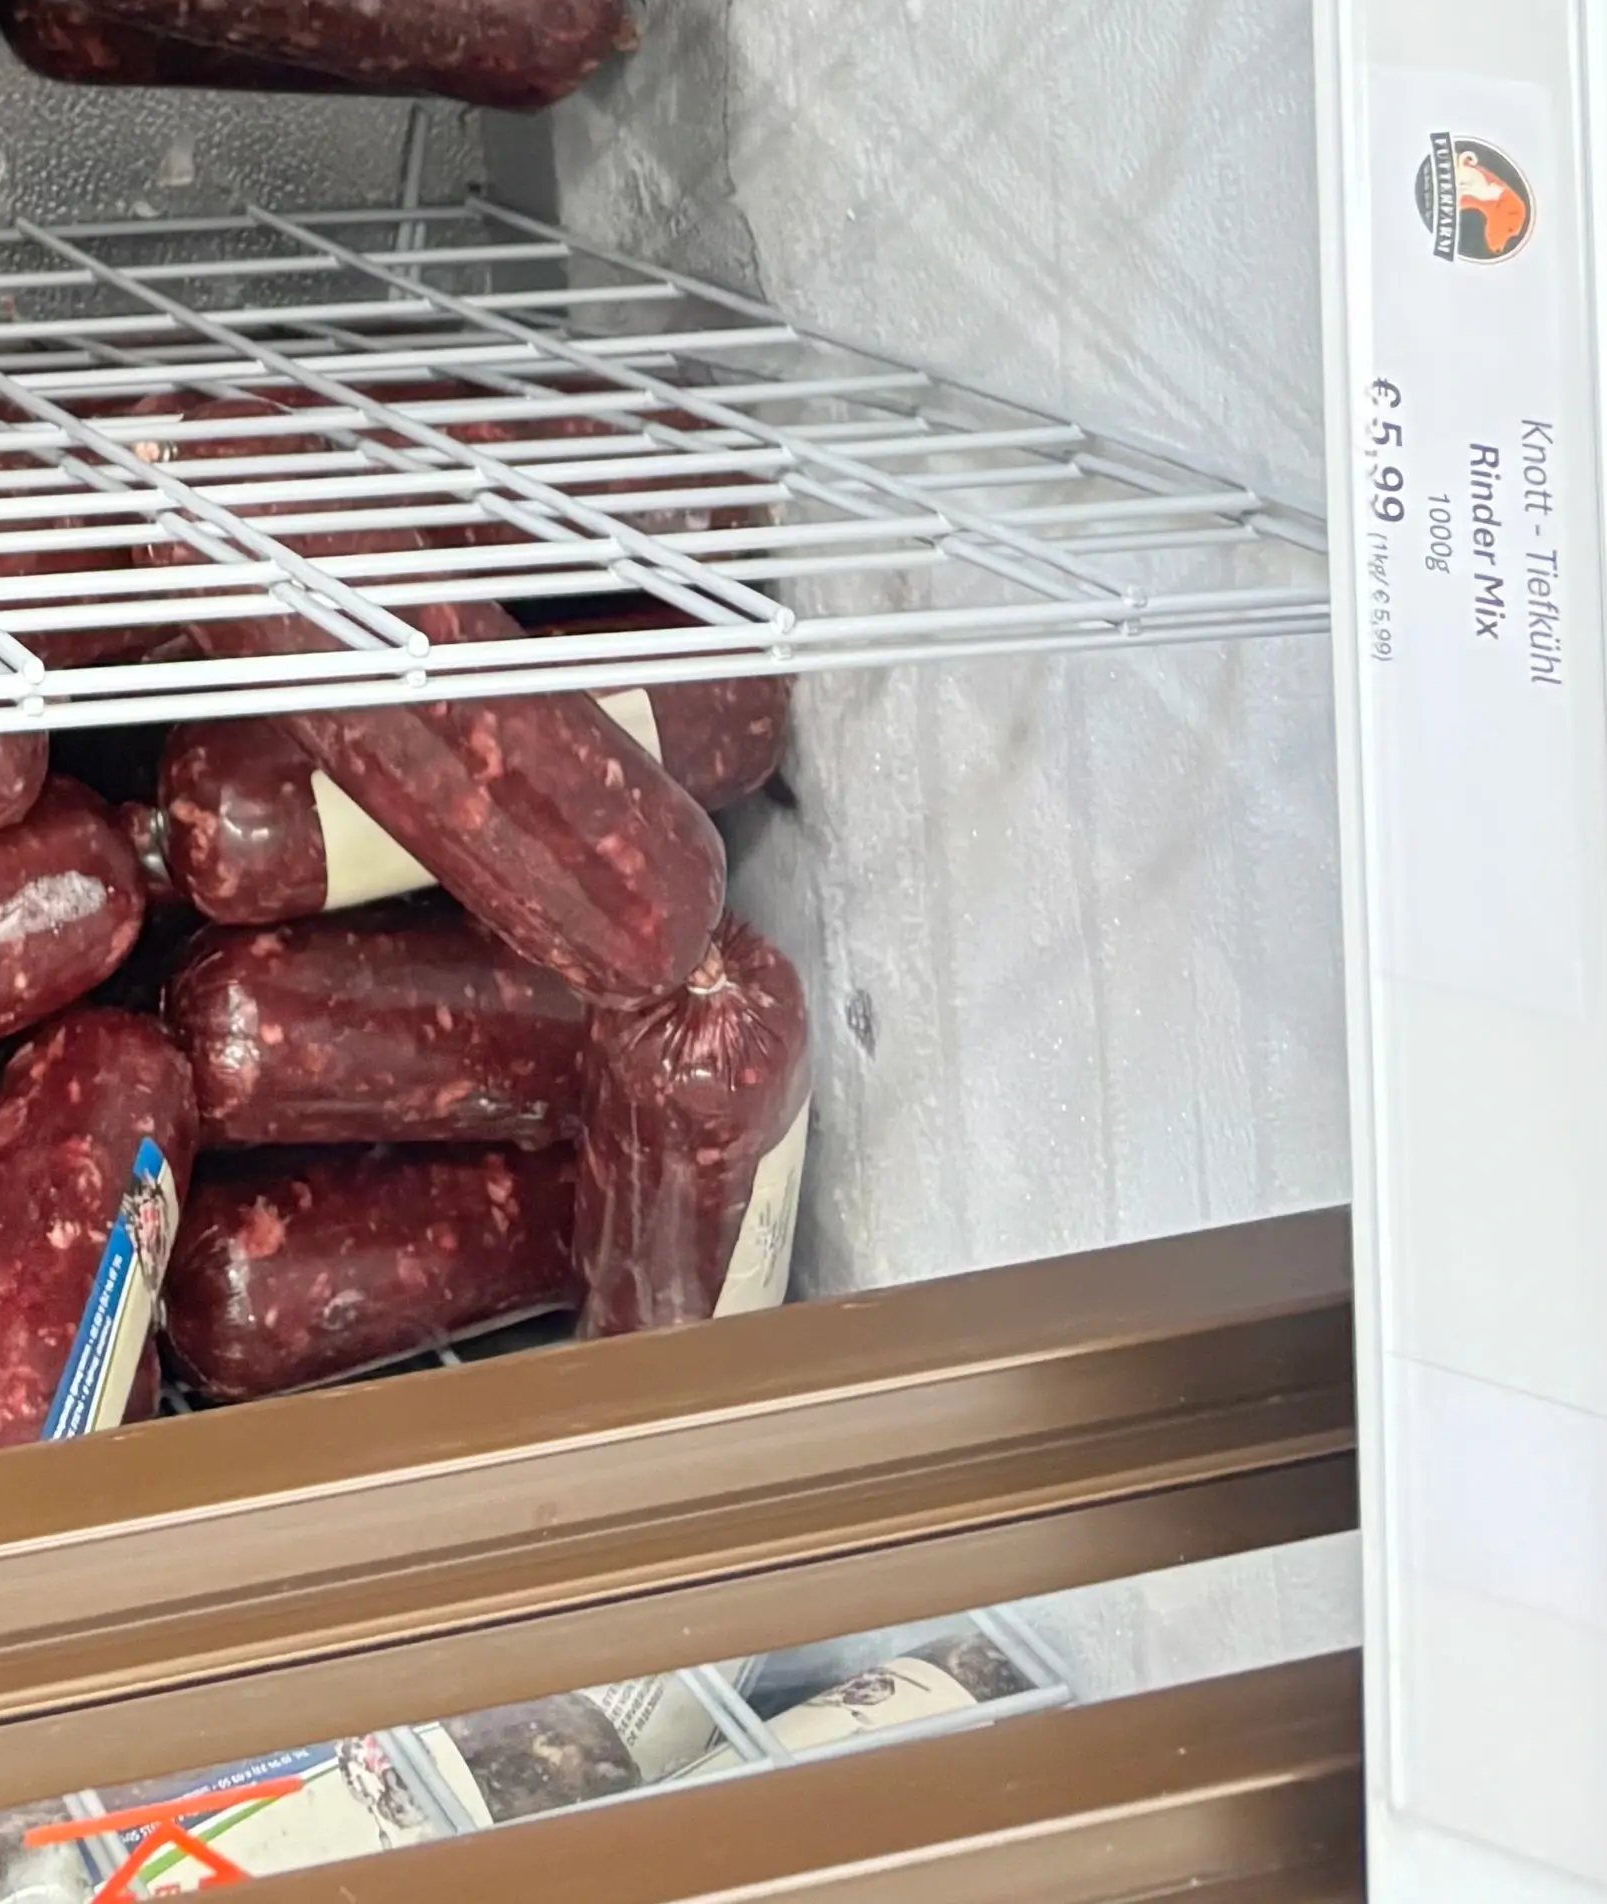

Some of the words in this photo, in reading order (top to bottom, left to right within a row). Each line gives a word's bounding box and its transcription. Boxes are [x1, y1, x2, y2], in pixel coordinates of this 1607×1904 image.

[1432, 137, 1454, 253] FUTTERFARM
[1372, 378, 1401, 408] €
[1366, 418, 1404, 522] 5,99
[1470, 444, 1502, 566] Rinder
[1522, 420, 1553, 516] Knott
[1425, 494, 1453, 574] 1000g
[1474, 574, 1506, 639] Mix
[1526, 550, 1562, 684] Tiefkühl
